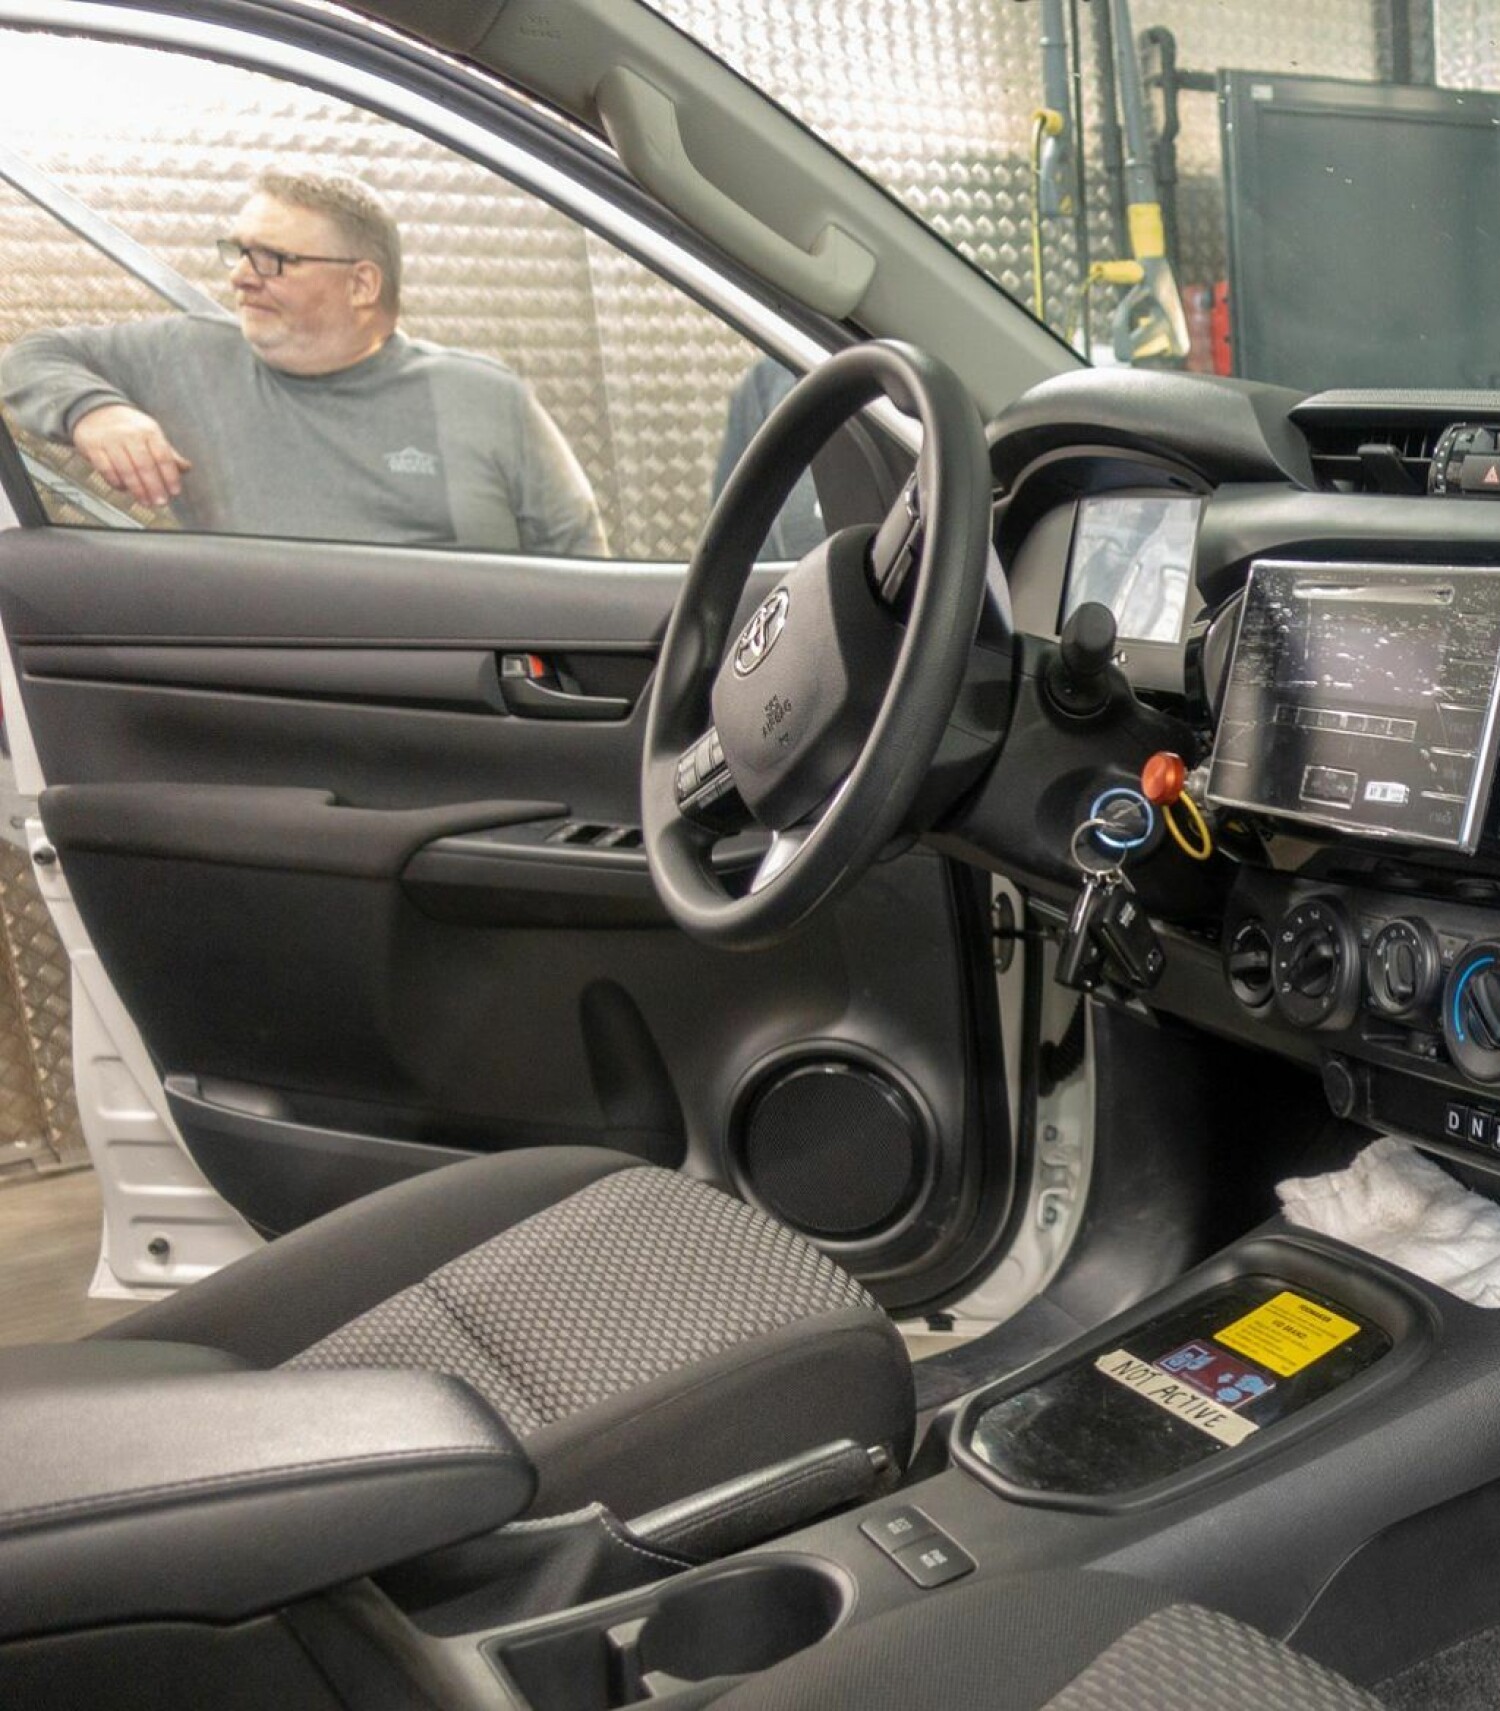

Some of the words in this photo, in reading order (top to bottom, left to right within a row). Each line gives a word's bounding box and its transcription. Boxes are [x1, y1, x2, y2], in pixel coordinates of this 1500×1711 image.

[1448, 1110, 1460, 1129] D
[1471, 1117, 1484, 1138] N
[1111, 1359, 1161, 1387] NOT
[1148, 1384, 1228, 1428] ACTIVE
